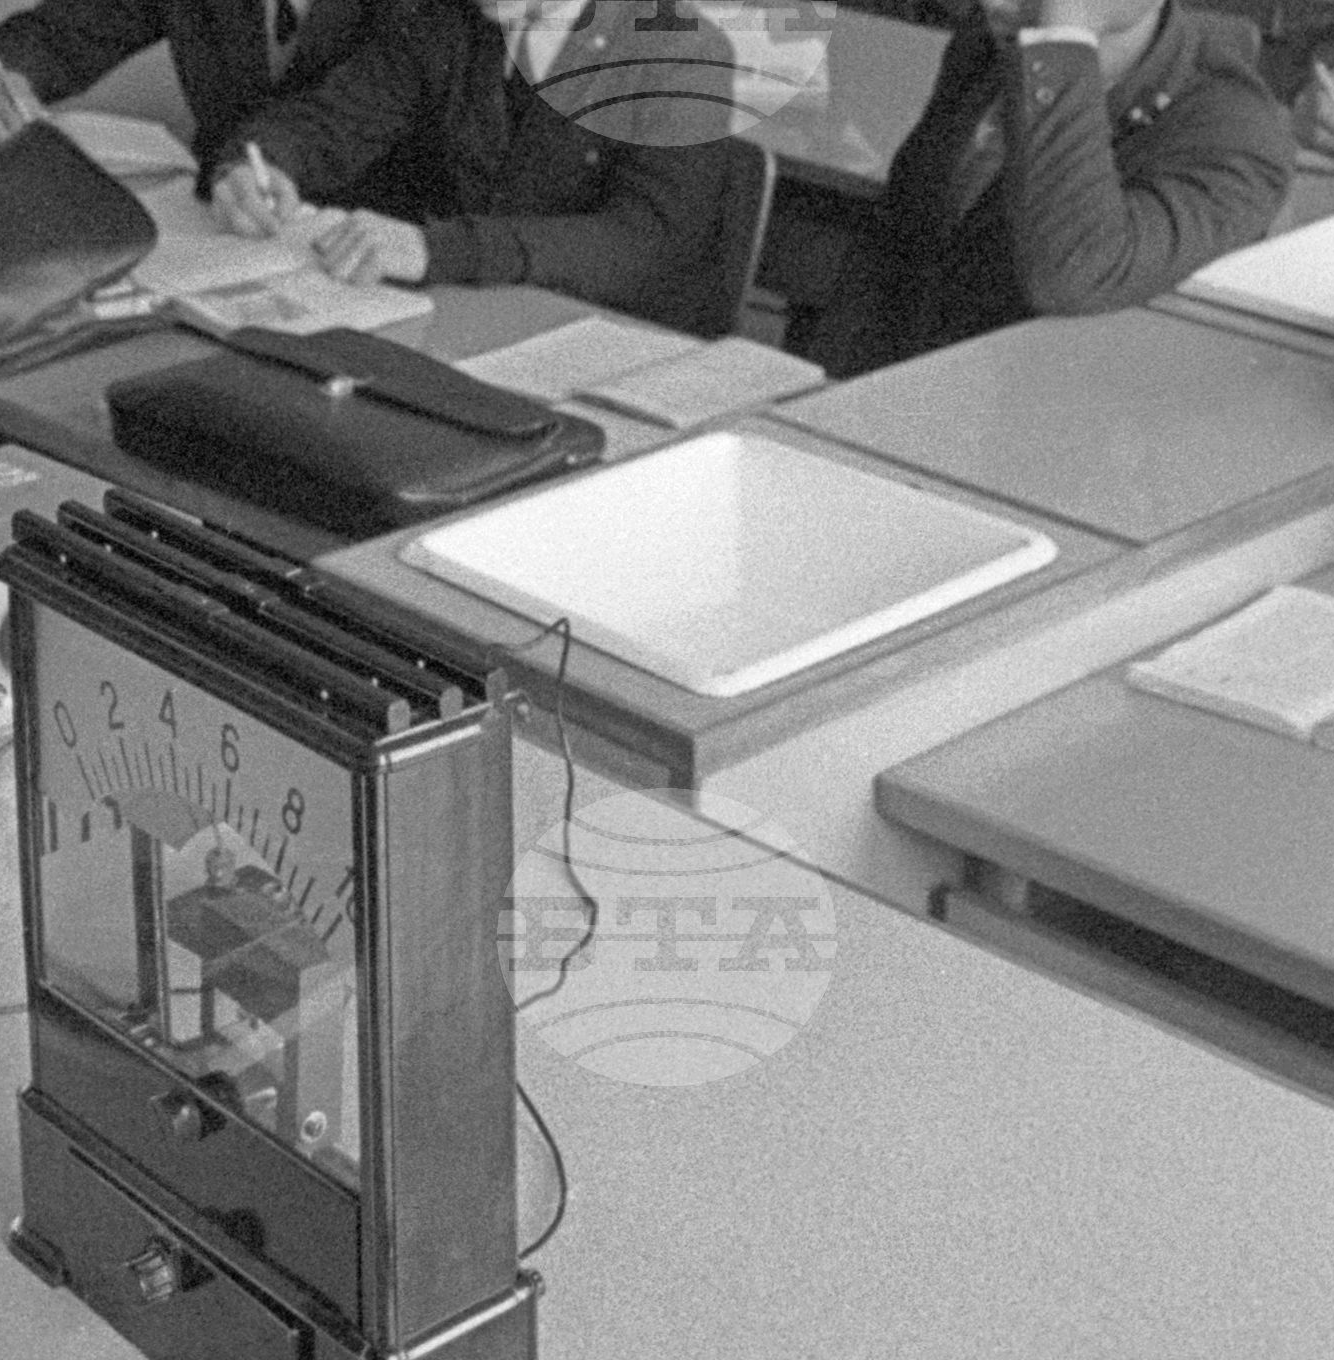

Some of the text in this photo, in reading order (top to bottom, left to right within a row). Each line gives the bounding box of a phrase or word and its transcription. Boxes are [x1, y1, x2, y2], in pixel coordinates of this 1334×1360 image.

[53, 700, 78, 749] 0
[99, 680, 125, 731] 2
[158, 690, 178, 739] 4
[219, 722, 241, 773] 6
[281, 787, 306, 835] 8
